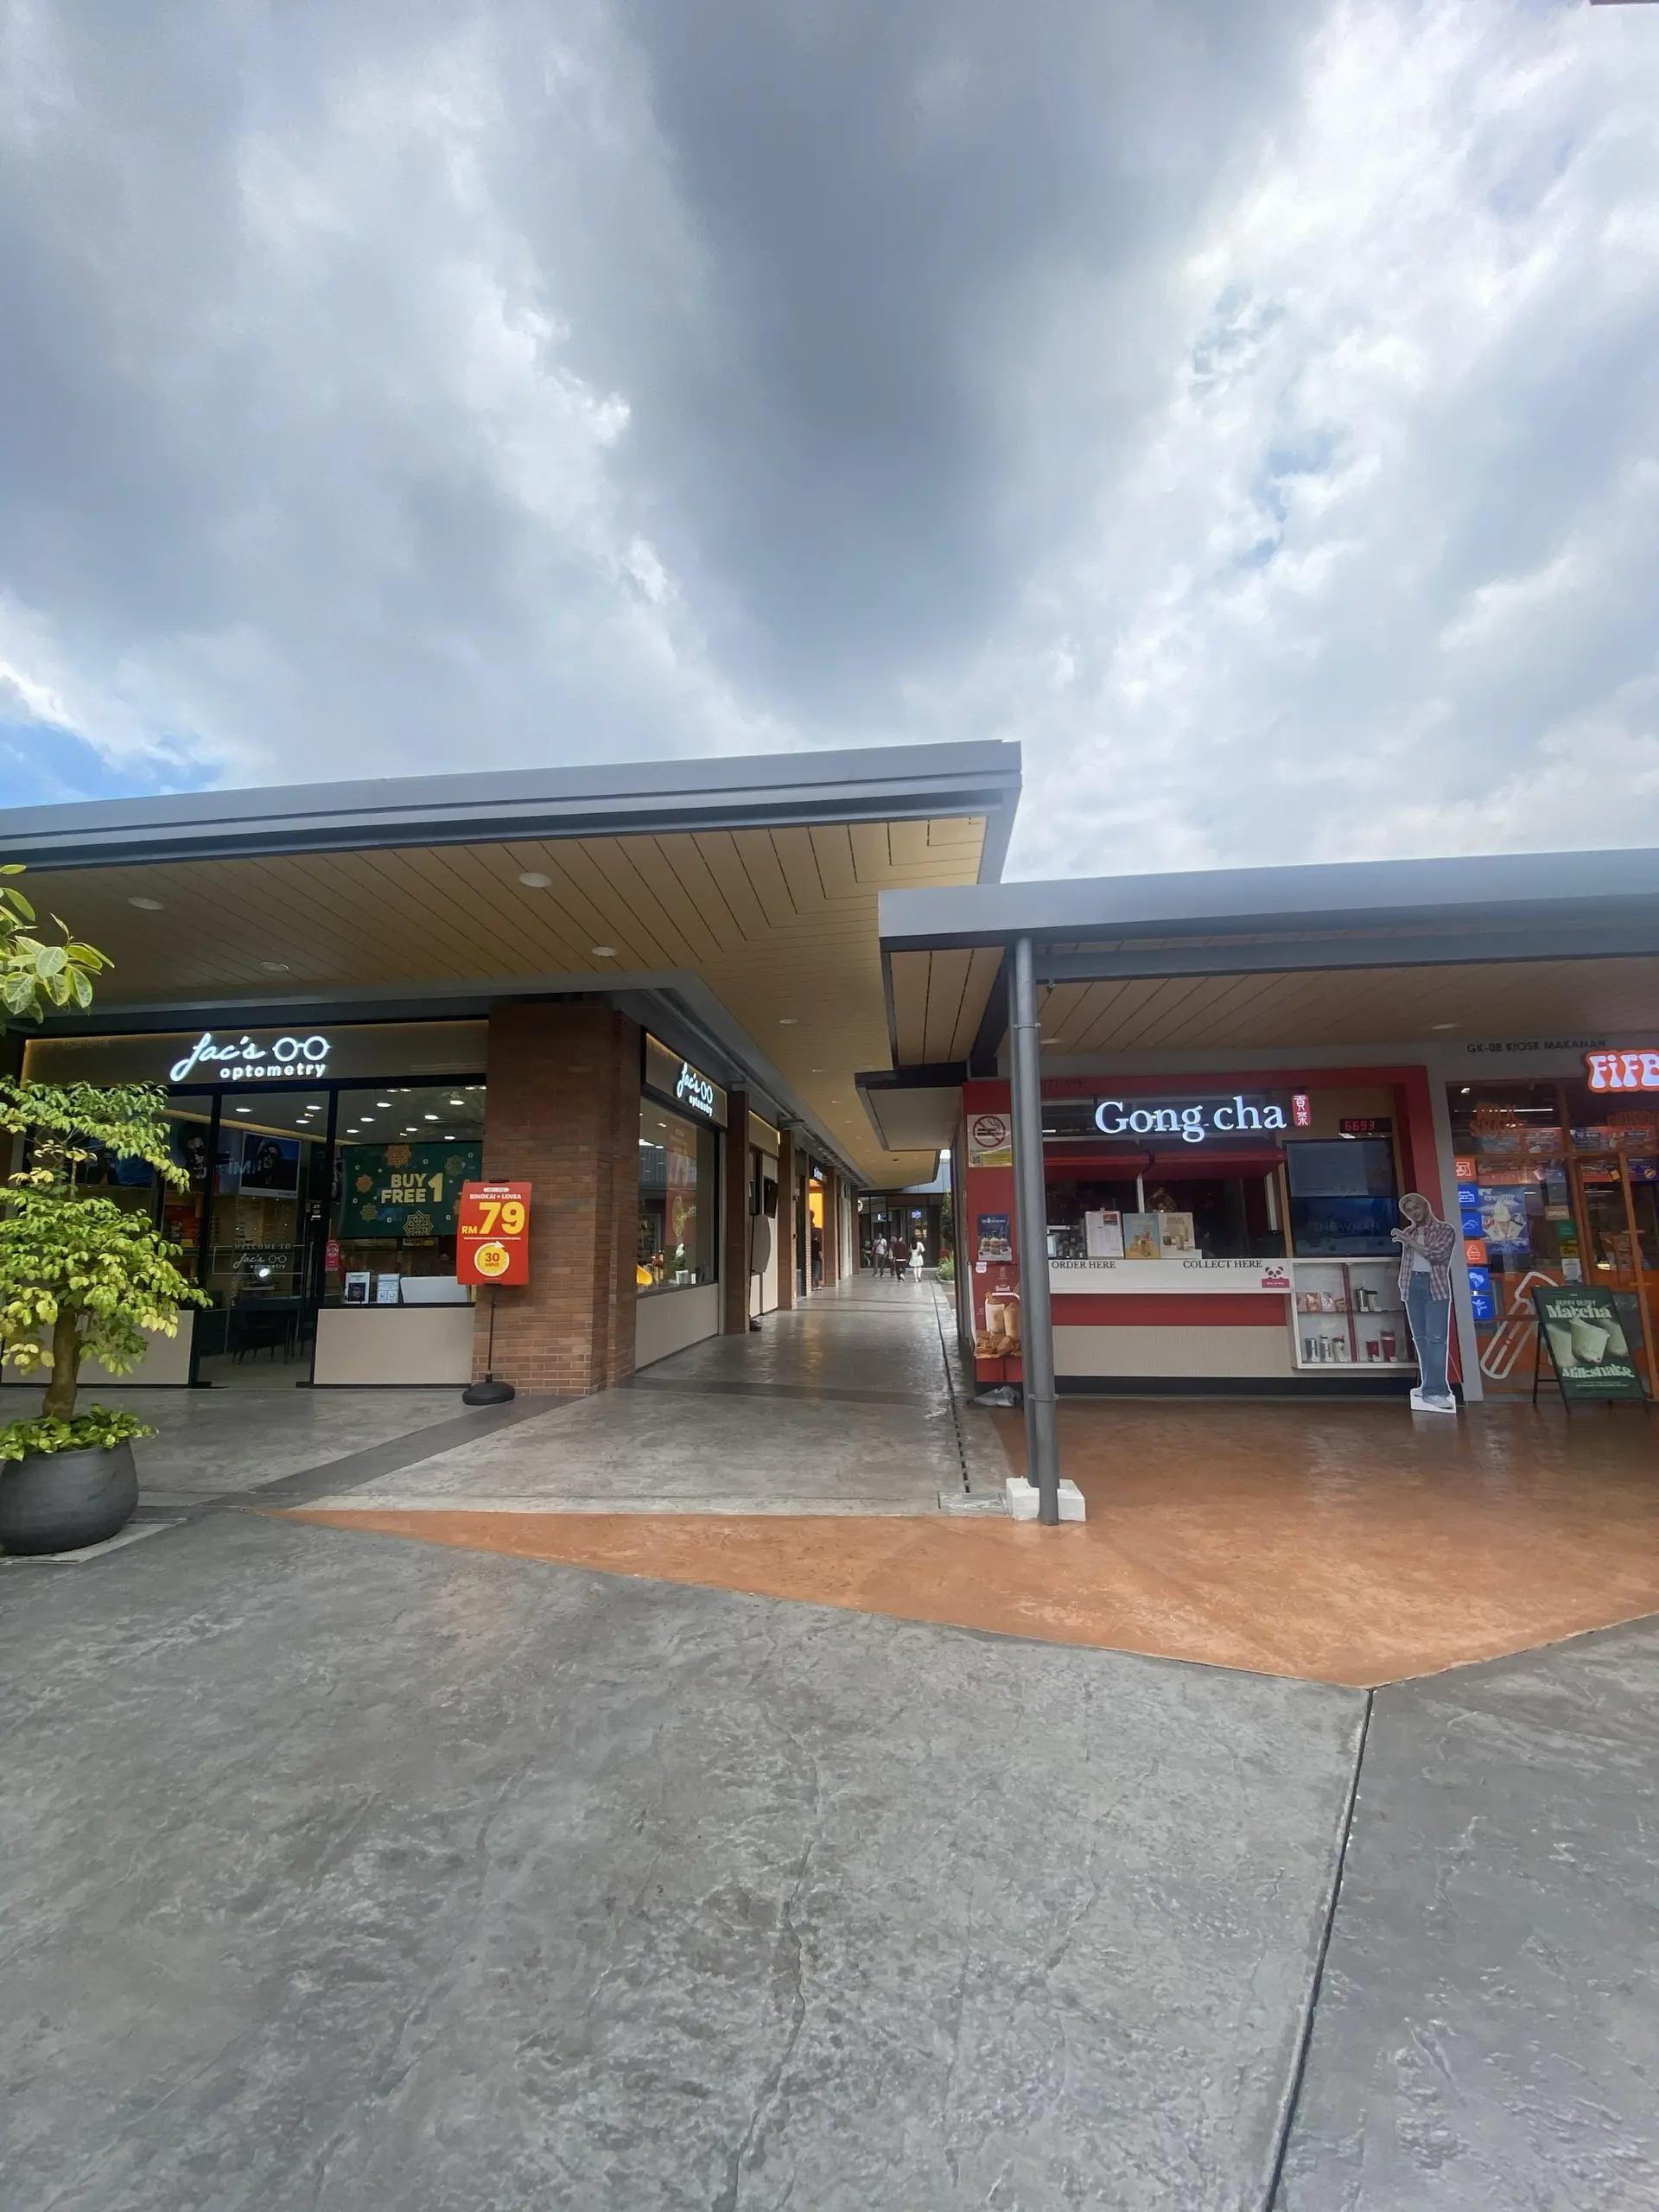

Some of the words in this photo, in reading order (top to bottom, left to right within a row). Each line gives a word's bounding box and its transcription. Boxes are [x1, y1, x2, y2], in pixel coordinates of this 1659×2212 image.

[1466, 1043, 1503, 1053] GK-08
[1506, 1041, 1541, 1052] KIOSK
[1544, 1039, 1606, 1050] MAKANAN
[169, 1032, 266, 1082] Jac's
[219, 1062, 327, 1080] optometry
[1095, 1101, 1204, 1143] Gong
[1213, 1096, 1287, 1130] cha
[381, 1188, 427, 1204] FREE
[391, 1173, 427, 1188] BUY
[427, 1173, 443, 1203] 1
[461, 1225, 478, 1235] RM
[479, 1201, 525, 1235] 79
[485, 1252, 500, 1262] 30
[1051, 1260, 1087, 1269] ORDER
[1088, 1260, 1116, 1269] HERE
[1183, 1260, 1232, 1268] COLLECT
[1234, 1259, 1263, 1268] HERE
[1545, 1303, 1612, 1319] Matcha
